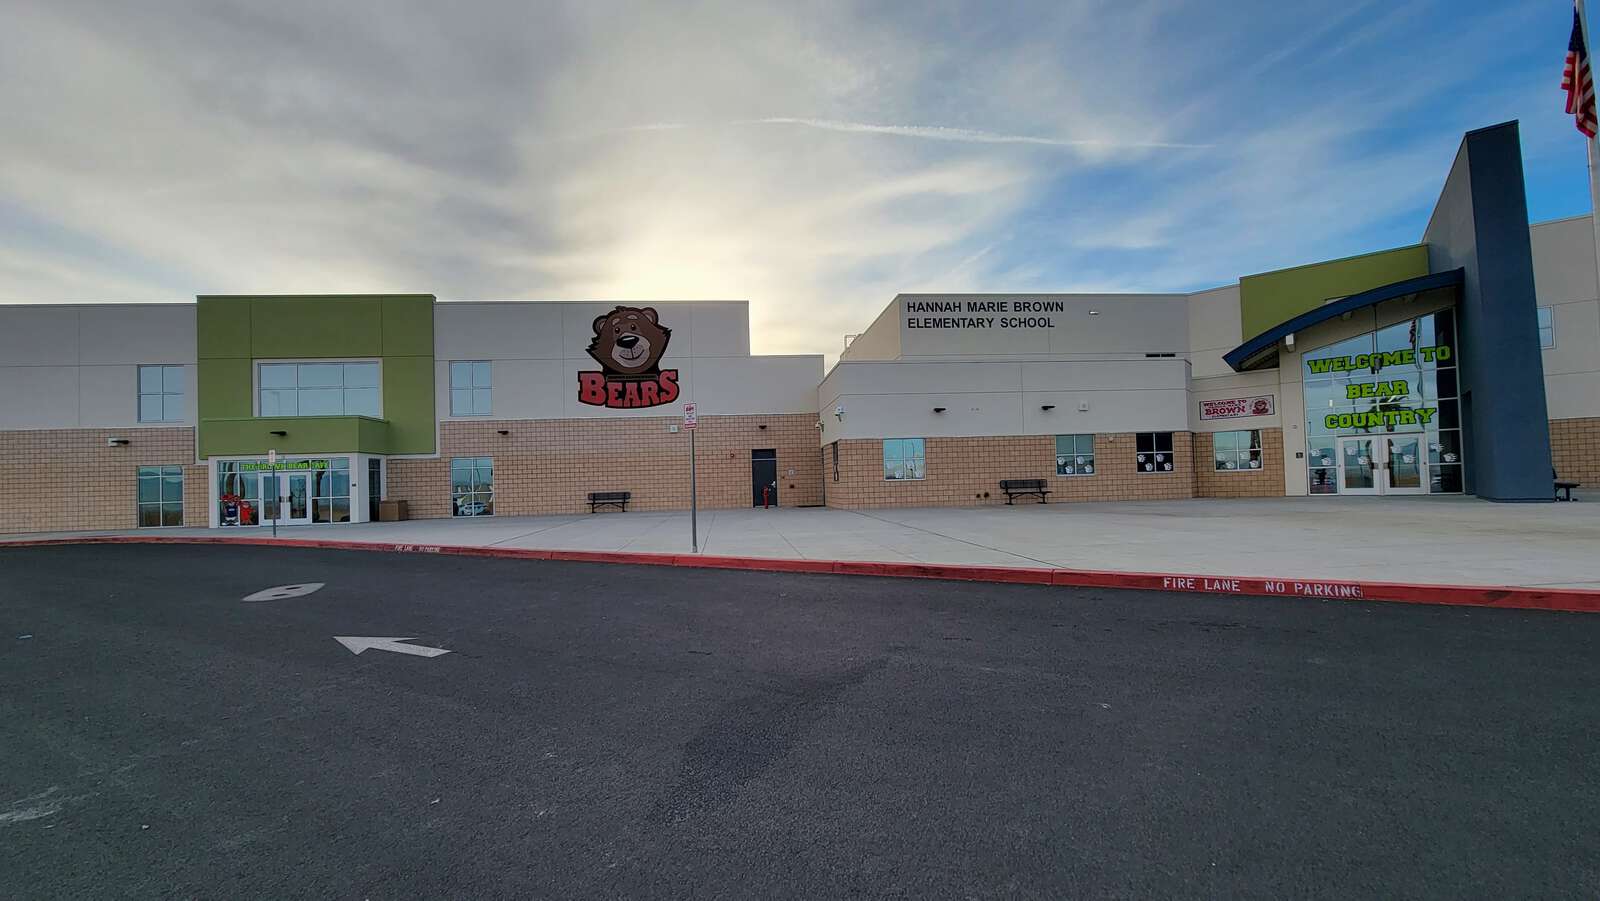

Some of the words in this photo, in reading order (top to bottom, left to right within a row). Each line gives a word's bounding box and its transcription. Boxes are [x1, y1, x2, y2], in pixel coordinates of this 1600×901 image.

[907, 301, 962, 312] HANNAH
[967, 301, 1008, 312] MARIE
[1013, 301, 1064, 312] BROWN
[908, 318, 994, 328] ELEMENTARY
[1000, 317, 1055, 328] SCHOOL
[1308, 349, 1415, 374] WELCOME
[1420, 346, 1451, 362] TO
[579, 370, 679, 407] BEARS
[1346, 380, 1410, 399] BEAR
[1205, 406, 1246, 416] BROWN
[1325, 408, 1437, 429] COUNTRY
[1164, 577, 1195, 589] FIRE
[1204, 579, 1241, 592] LANE
[1265, 581, 1285, 593] NO
[1294, 583, 1362, 597] PARKING
